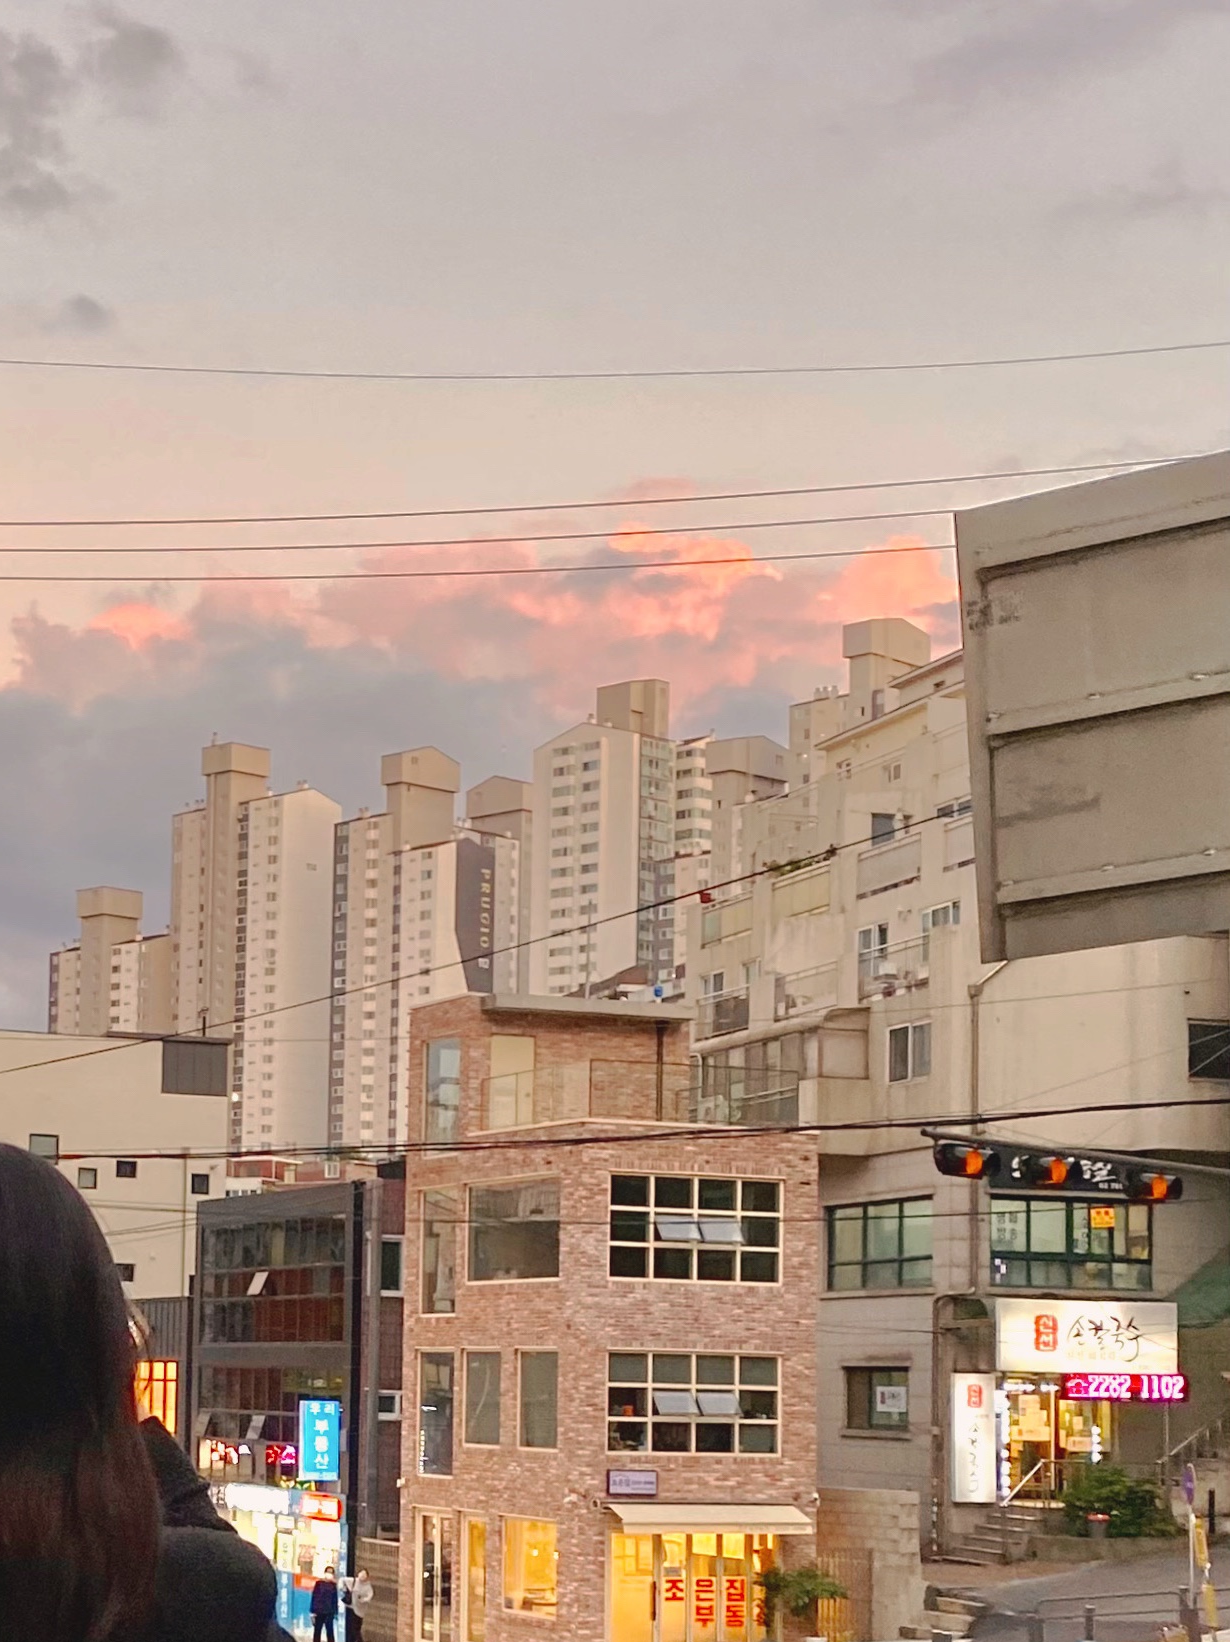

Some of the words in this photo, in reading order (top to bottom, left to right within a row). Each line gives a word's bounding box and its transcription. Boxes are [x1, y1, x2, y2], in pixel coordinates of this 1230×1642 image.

[480, 868, 491, 948] PRUGIO
[1088, 1374, 1132, 1398] 2282
[1140, 1375, 1184, 1399] 1102
[313, 1419, 330, 1470] 부동산
[664, 1578, 746, 1603] 조은집
